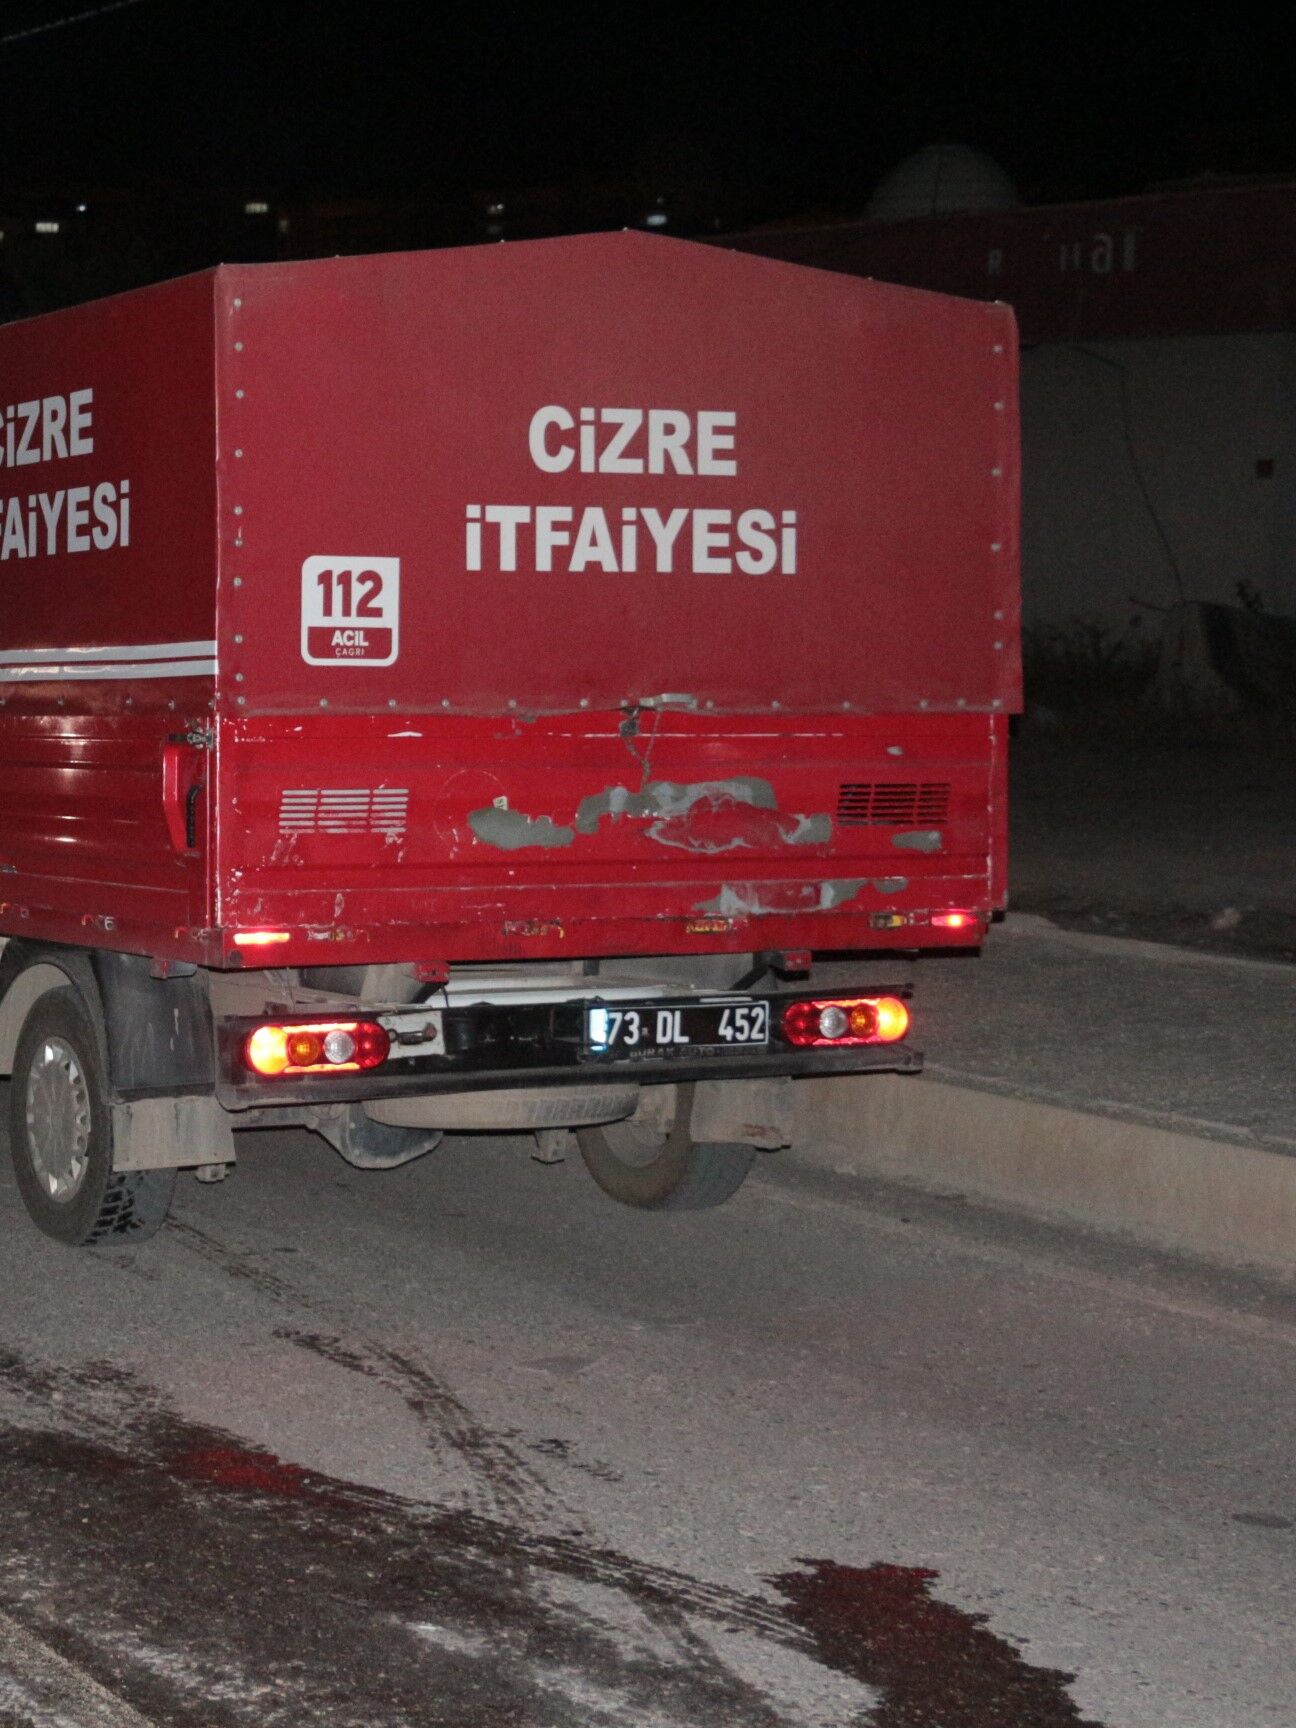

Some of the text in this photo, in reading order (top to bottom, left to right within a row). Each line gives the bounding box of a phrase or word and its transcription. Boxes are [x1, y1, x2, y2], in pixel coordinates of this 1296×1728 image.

[316, 568, 384, 619] 112
[607, 1006, 766, 1046] 73 DL 452
